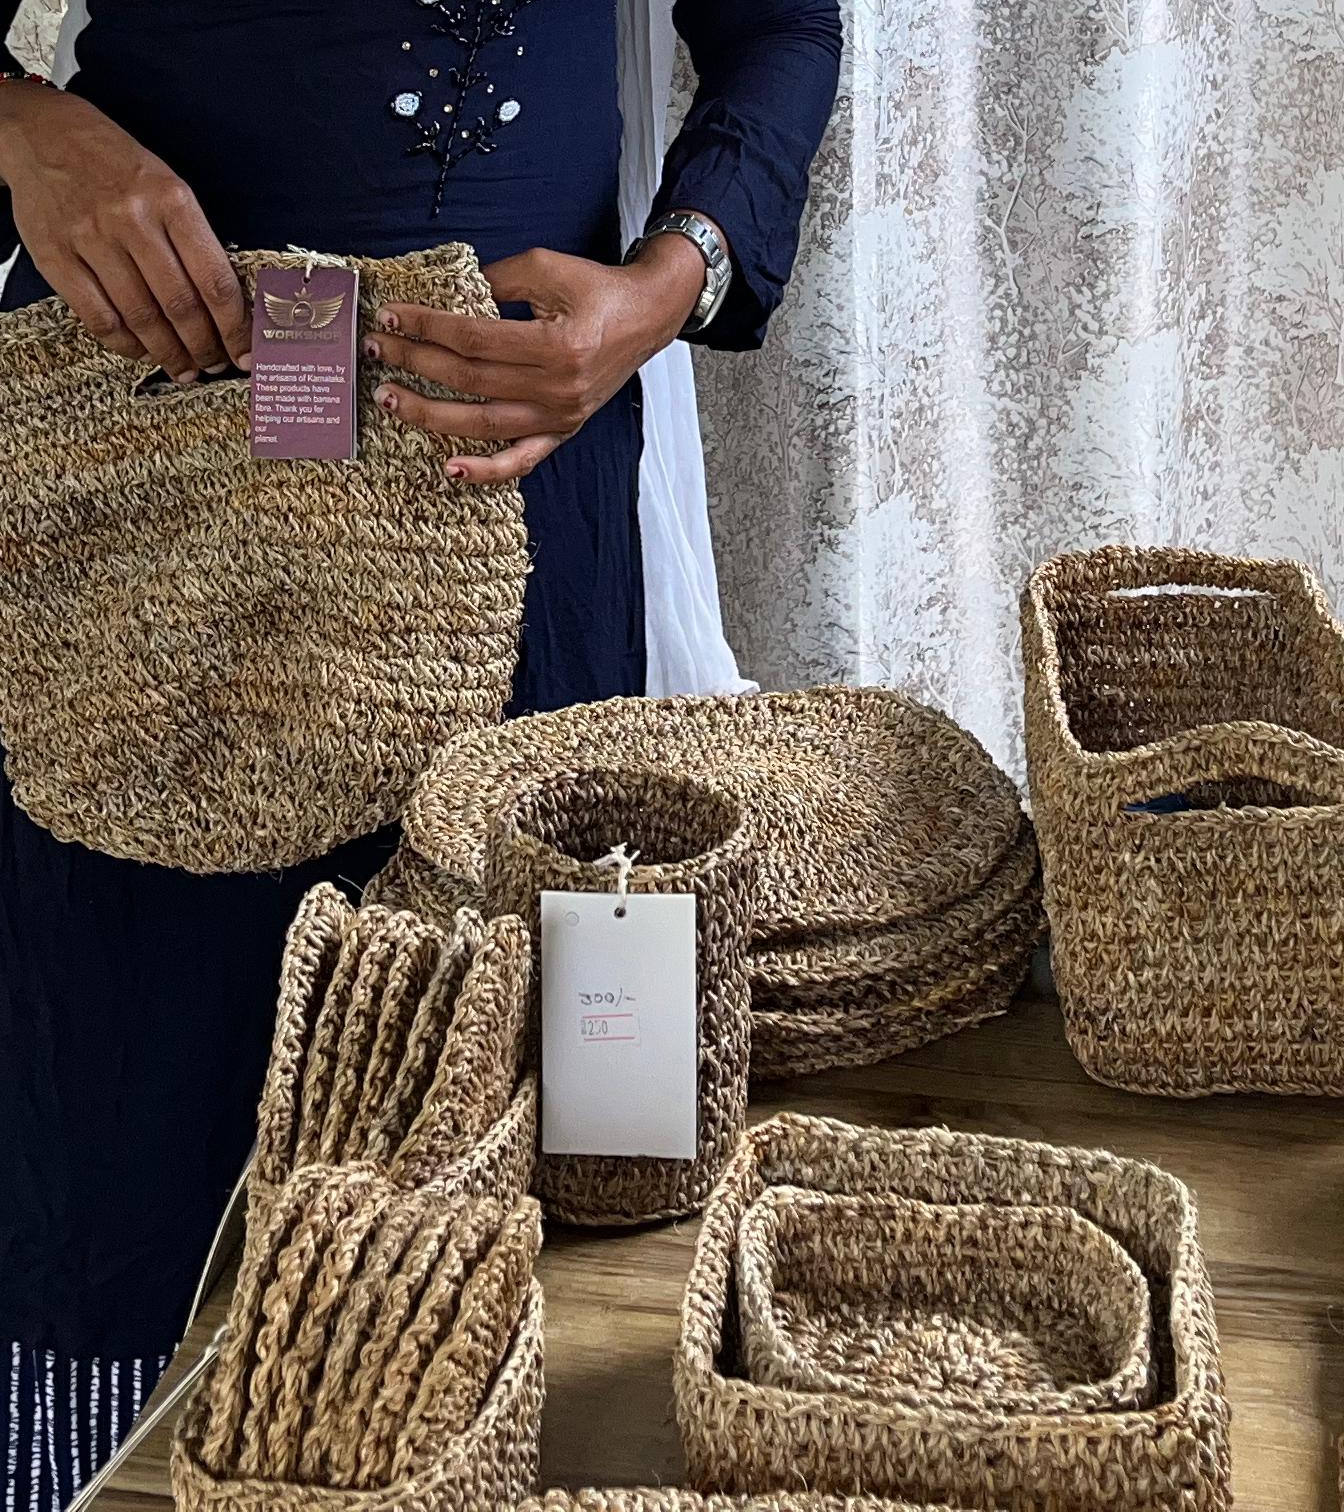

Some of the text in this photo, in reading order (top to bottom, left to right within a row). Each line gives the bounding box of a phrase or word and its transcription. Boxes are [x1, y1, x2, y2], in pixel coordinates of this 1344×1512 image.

[263, 329, 341, 340] WORKSHOP
[256, 363, 300, 372] Handcrafted
[301, 364, 316, 372] with
[336, 364, 346, 375] by
[256, 373, 267, 382] the
[268, 374, 297, 382] artisans
[298, 374, 307, 382] of
[256, 383, 330, 393] These products have
[255, 394, 274, 402] been
[275, 394, 296, 402] made
[313, 396, 341, 404] banana
[275, 404, 298, 412] Thank
[299, 406, 312, 414] you
[314, 405, 325, 413] for
[255, 414, 282, 424] helping
[296, 416, 325, 424] artisans
[326, 416, 340, 424] and
[578, 986, 636, 1007] 300/-
